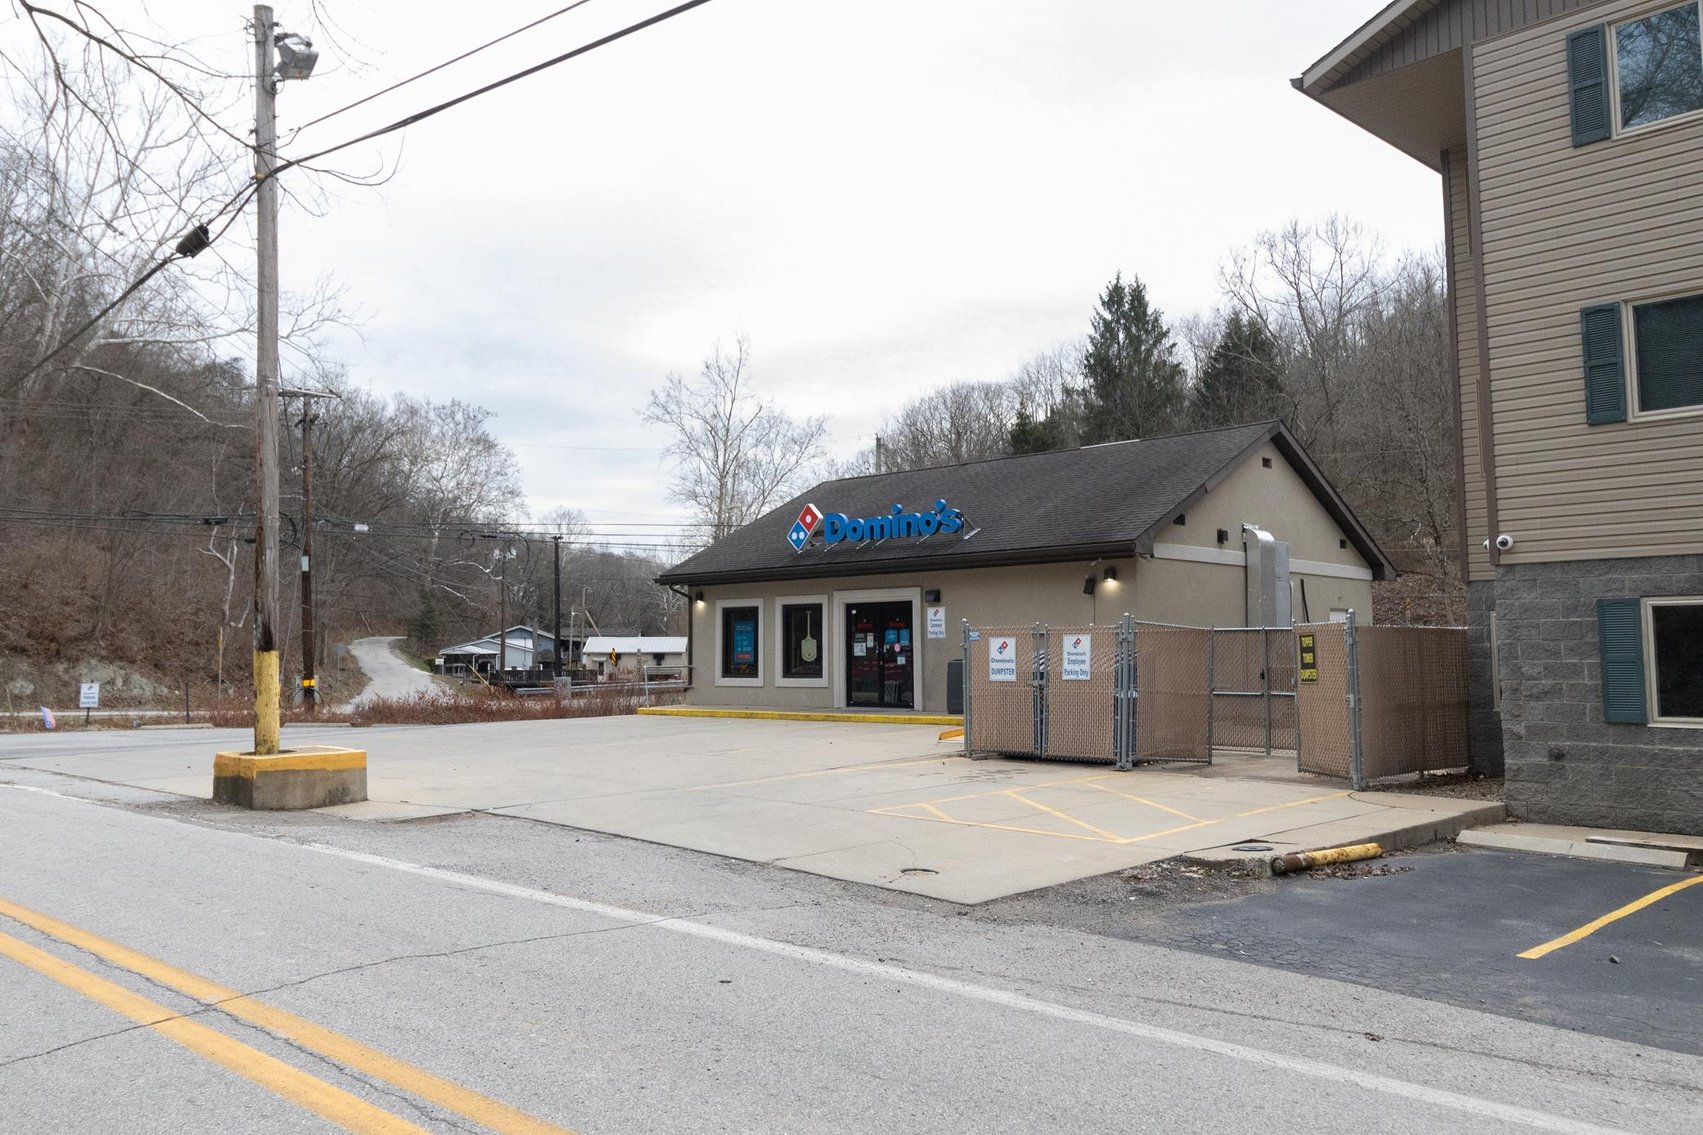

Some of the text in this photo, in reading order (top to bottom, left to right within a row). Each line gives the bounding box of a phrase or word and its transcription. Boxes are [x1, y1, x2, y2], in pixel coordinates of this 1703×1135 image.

[824, 499, 963, 544] Domino's
[1067, 657, 1086, 666] Employee
[991, 668, 1015, 676] DUMPSTER
[1064, 668, 1089, 678] Parking Only
